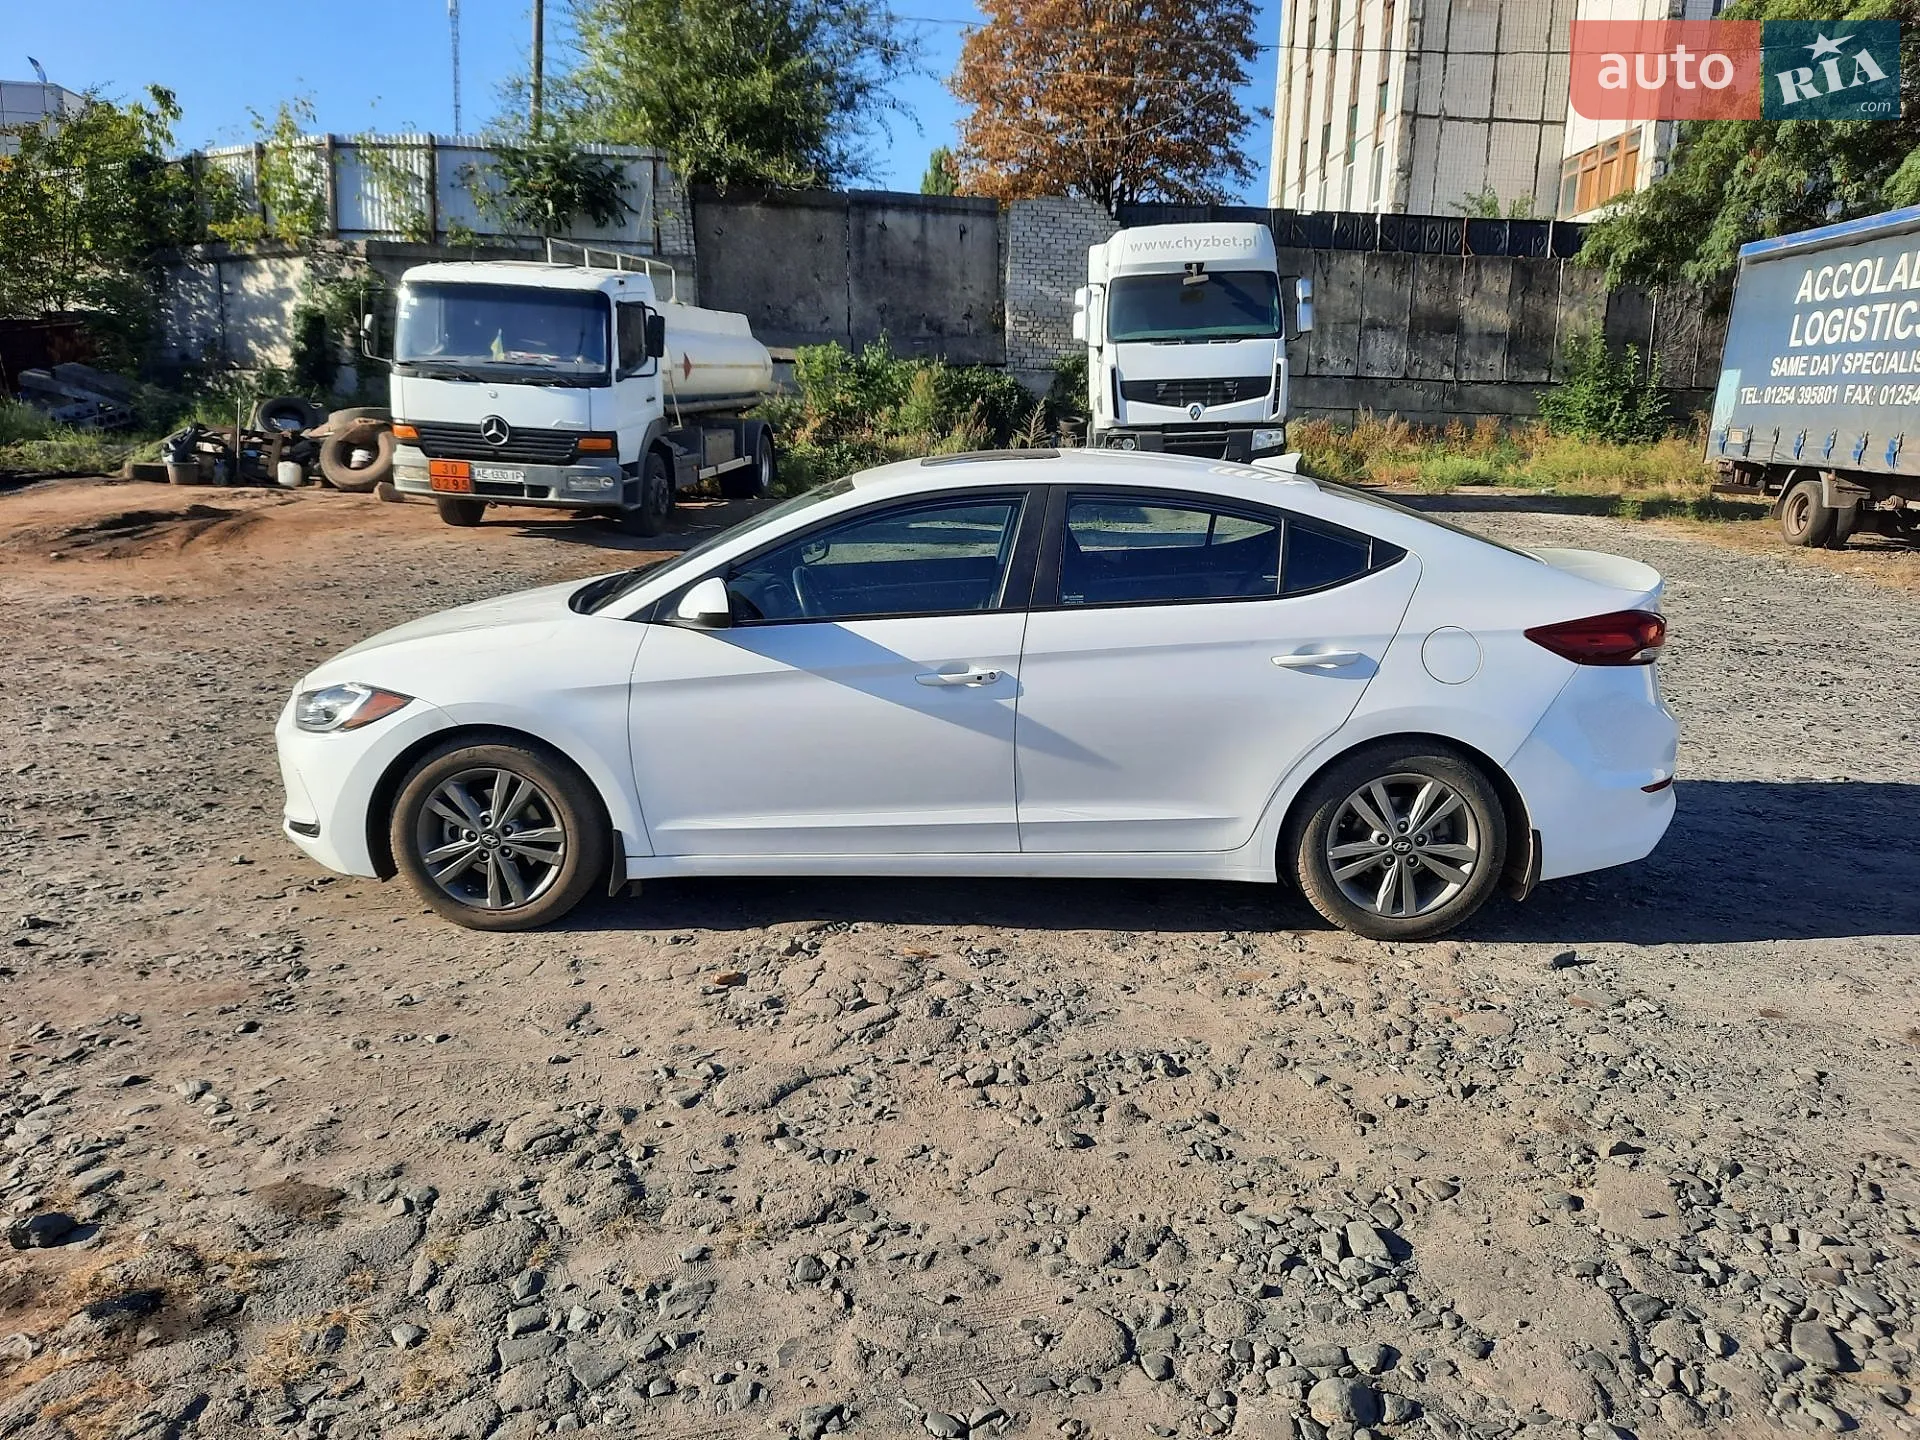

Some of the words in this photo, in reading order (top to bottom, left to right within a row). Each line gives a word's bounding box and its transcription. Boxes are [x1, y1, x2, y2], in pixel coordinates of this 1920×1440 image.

[1130, 235, 1257, 252] www.chyzbet.pl
[1788, 300, 1920, 348] LOGISTIC
[1770, 355, 1809, 377] SAME
[1809, 353, 1842, 376] DAY
[1740, 387, 1763, 405] TEL:
[1764, 385, 1797, 405] 01254
[1797, 384, 1839, 405] 395801
[1843, 384, 1876, 406] FAX:
[442, 463, 458, 475] 30
[434, 478, 469, 490] 3295
